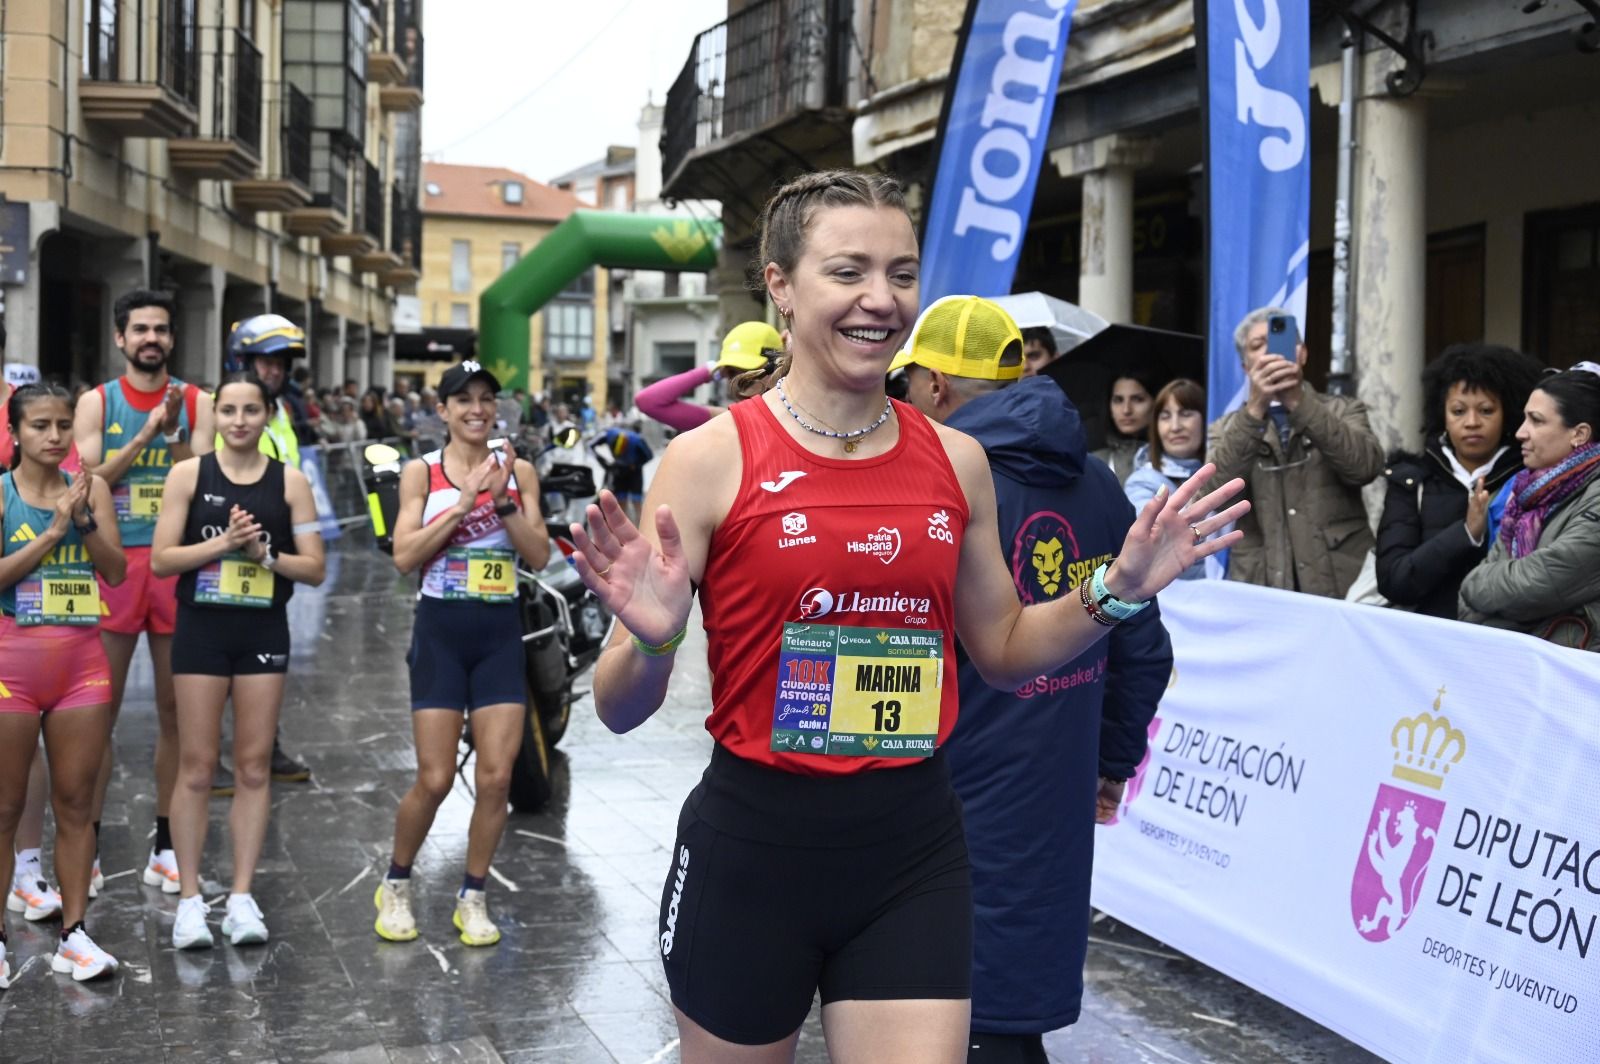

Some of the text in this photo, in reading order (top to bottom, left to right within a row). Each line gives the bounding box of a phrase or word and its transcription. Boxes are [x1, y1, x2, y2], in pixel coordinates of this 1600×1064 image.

[953, 0, 1069, 262] Jom
[150, 501, 159, 513] 5
[778, 535, 817, 549] Llanes
[868, 533, 892, 542] Patria
[847, 541, 893, 554] Hispana
[483, 562, 503, 581] 28
[49, 583, 91, 596] TISALEMA
[241, 581, 250, 594] 6
[66, 599, 75, 614] 4
[834, 590, 931, 613] Llamieva
[904, 615, 928, 626] Grupo
[785, 636, 832, 648] Telenauto
[889, 635, 938, 646] CAJA RURAL
[786, 659, 831, 683] 10K
[855, 664, 921, 693] MARINA
[781, 680, 831, 692] CIUDAD DE
[780, 690, 831, 702] ASTORGA
[811, 703, 827, 716] 26
[871, 700, 901, 733] 13
[798, 720, 828, 730] CAJÓN A
[881, 739, 934, 750] CAJA RURAL
[1163, 722, 1306, 794] DIPUTACIÓN
[1153, 765, 1248, 827] DE LEÓN
[1140, 820, 1180, 848] DEPORTES
[1183, 839, 1231, 869] JUVENTUD
[1436, 864, 1598, 959] DE LEÓN
[1422, 937, 1578, 1014] DEPORTES Y JUVENTUD
